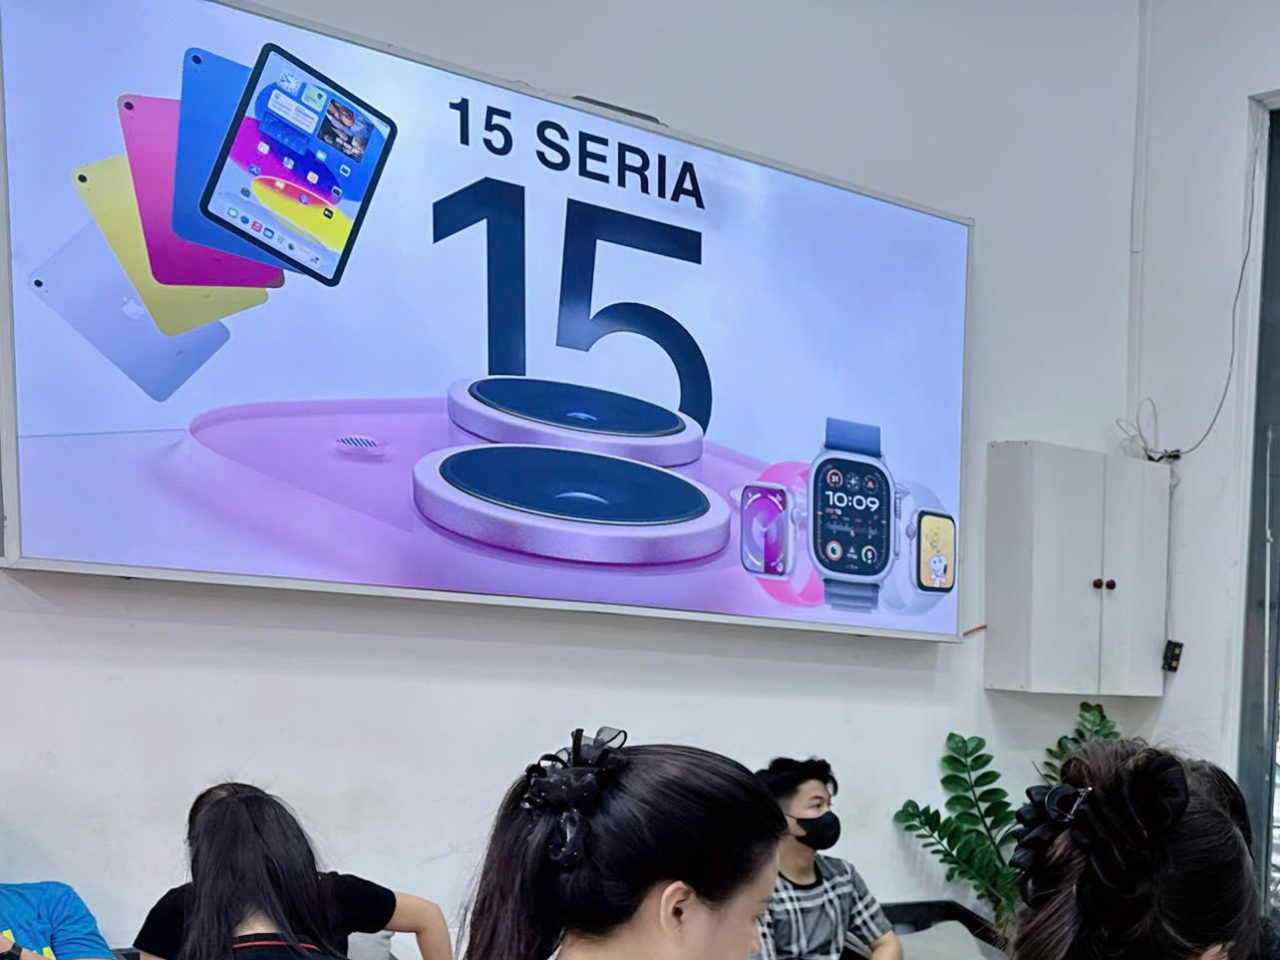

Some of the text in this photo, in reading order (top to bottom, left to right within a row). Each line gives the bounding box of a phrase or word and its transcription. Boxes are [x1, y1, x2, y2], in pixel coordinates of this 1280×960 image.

[449, 97, 706, 210] 15 SERIA
[433, 176, 713, 437] 15
[825, 490, 880, 512] 10:09
